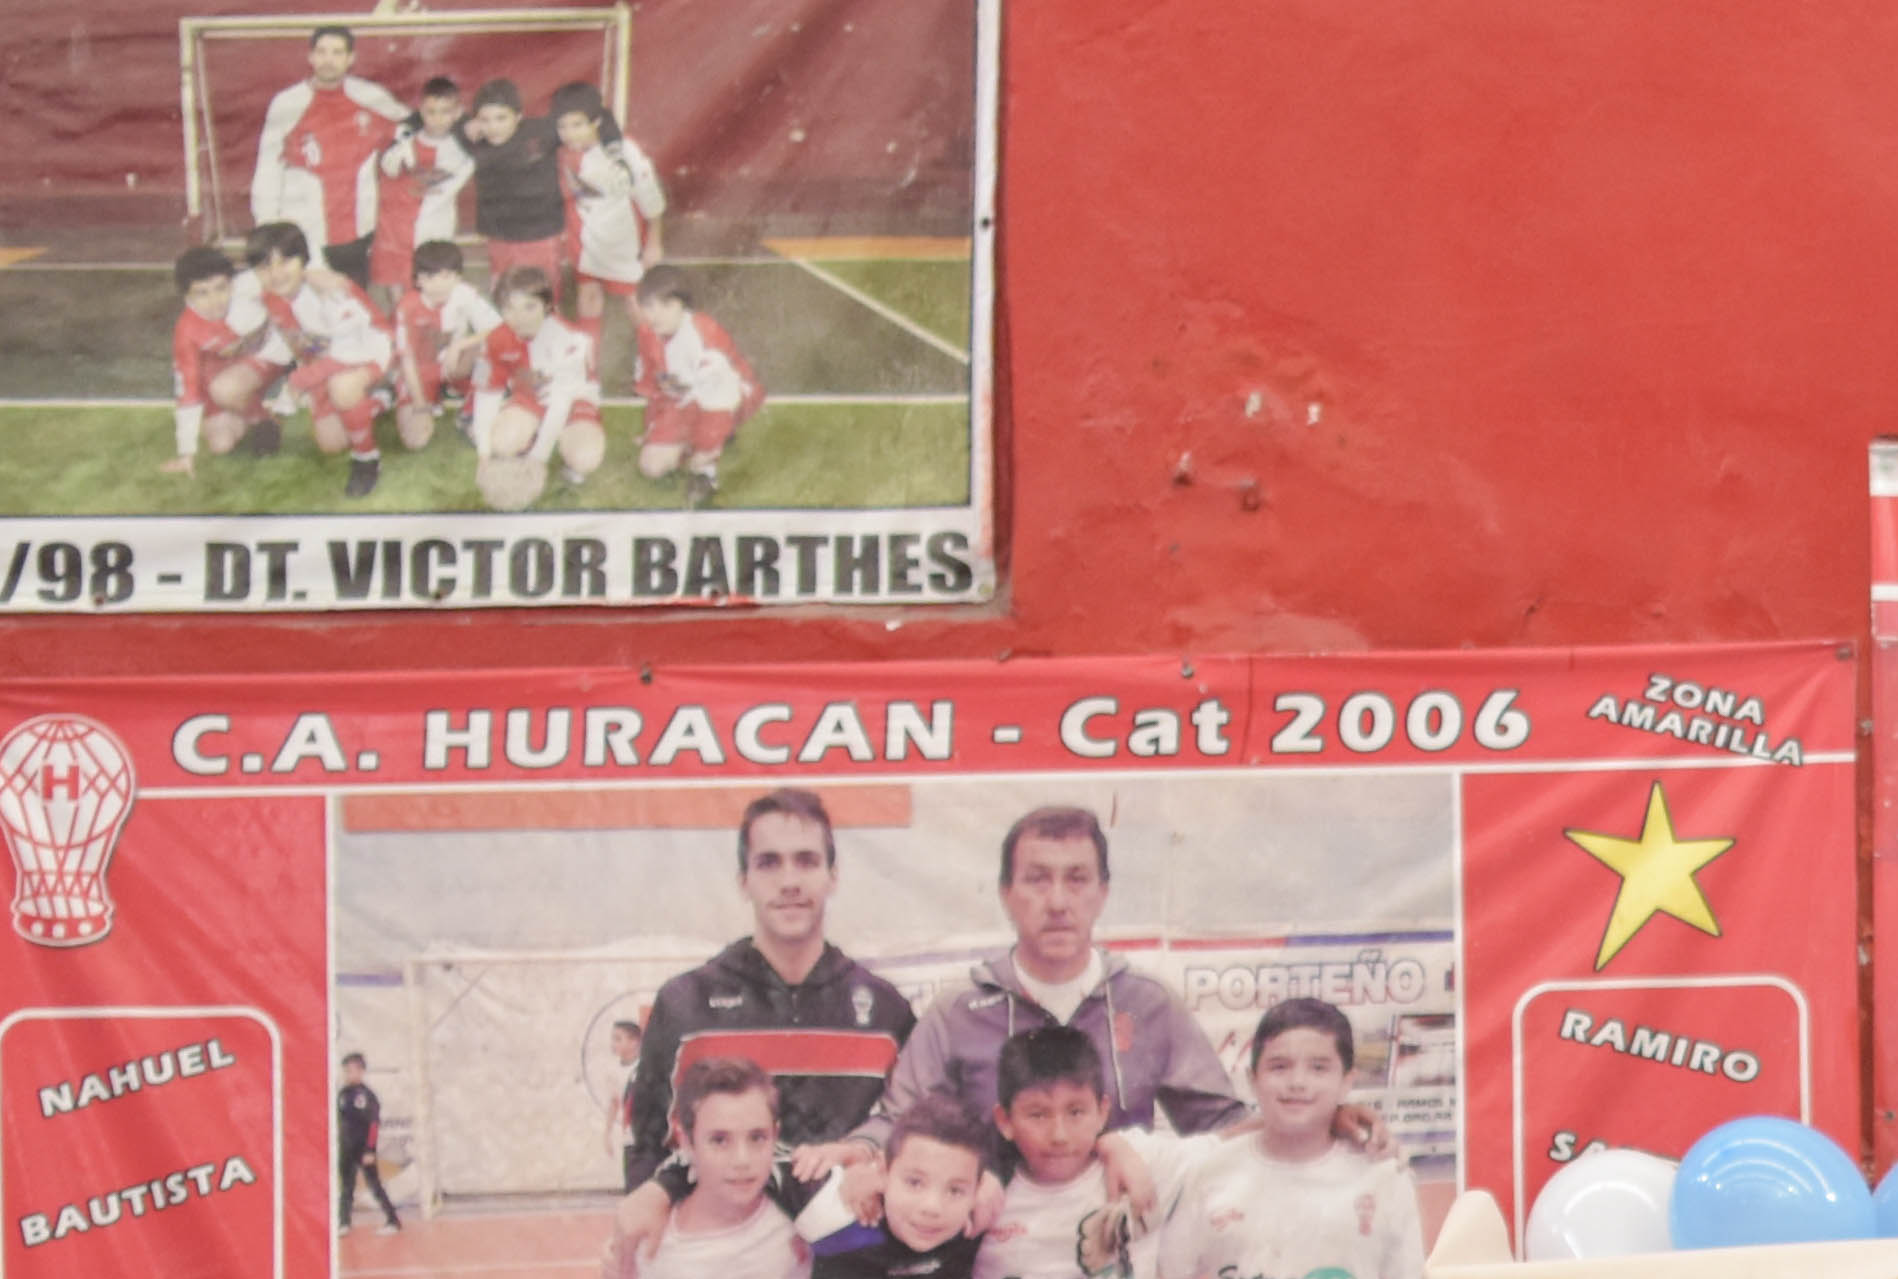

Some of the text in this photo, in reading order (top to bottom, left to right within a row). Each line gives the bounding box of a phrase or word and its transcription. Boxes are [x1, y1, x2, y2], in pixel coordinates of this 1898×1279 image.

[204, 540, 308, 602] DT.
[327, 537, 608, 600] VICTOR
[631, 531, 974, 598] BARTHES
[171, 710, 382, 775] C.A.
[422, 699, 957, 770] HURACAN
[1058, 695, 1231, 758] Cat
[1269, 688, 1532, 754] 2006
[1586, 693, 1805, 767] AMARILLA
[1642, 673, 1767, 727] ZONA
[1184, 949, 1427, 1013] PORTEÑO
[38, 1037, 236, 1118] NAHUEL
[1560, 1008, 1762, 1083] RAMIRO
[20, 1155, 258, 1247] BAUTISTA
